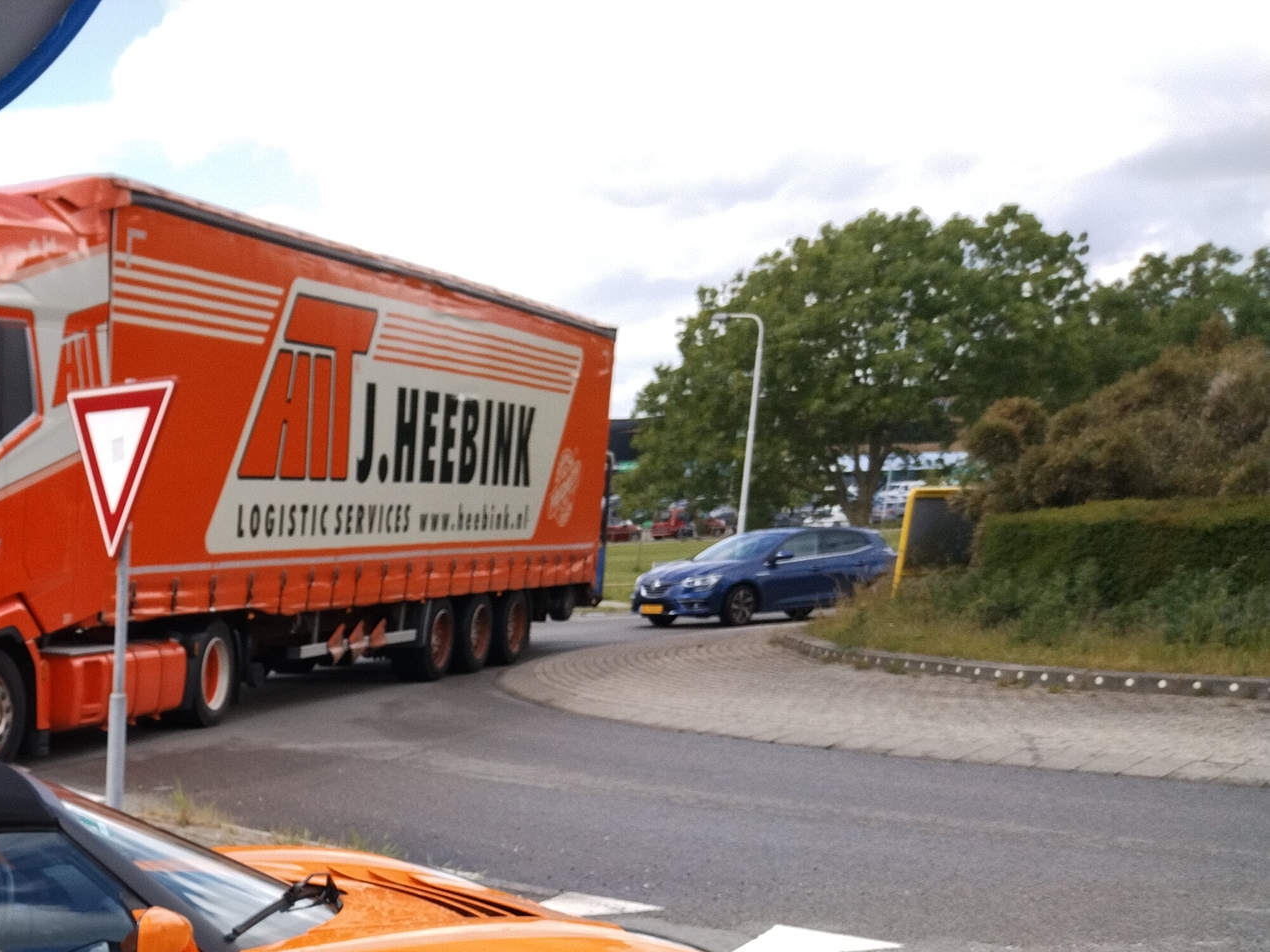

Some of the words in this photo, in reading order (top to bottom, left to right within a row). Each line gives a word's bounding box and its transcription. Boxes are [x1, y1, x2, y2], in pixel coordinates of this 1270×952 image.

[355, 382, 536, 488] J.HEEBINK
[236, 503, 328, 538] LOGISTIC
[334, 503, 411, 535] SERVICES
[419, 503, 529, 532] www.heebink.nl
